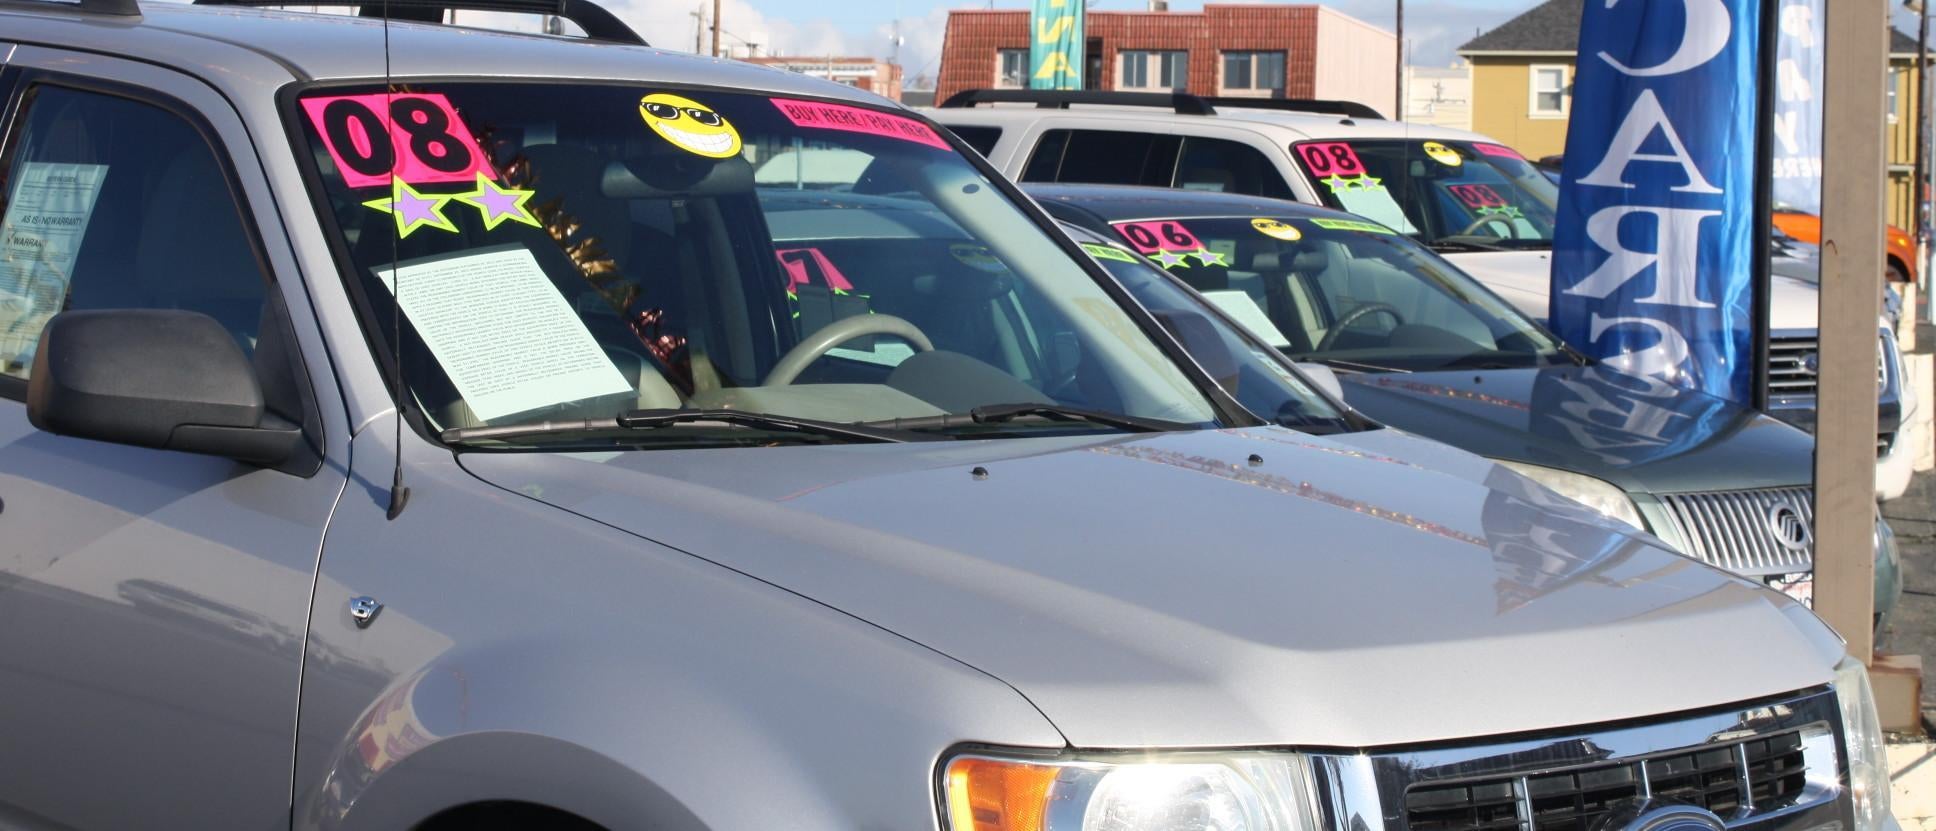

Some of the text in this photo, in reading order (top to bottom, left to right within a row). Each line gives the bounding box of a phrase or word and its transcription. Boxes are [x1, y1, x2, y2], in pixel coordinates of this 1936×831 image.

[784, 103, 818, 121] BUY
[896, 119, 930, 139] HERE
[323, 98, 472, 177] 08
[1305, 145, 1358, 172] 08
[1124, 223, 1193, 249] 06
